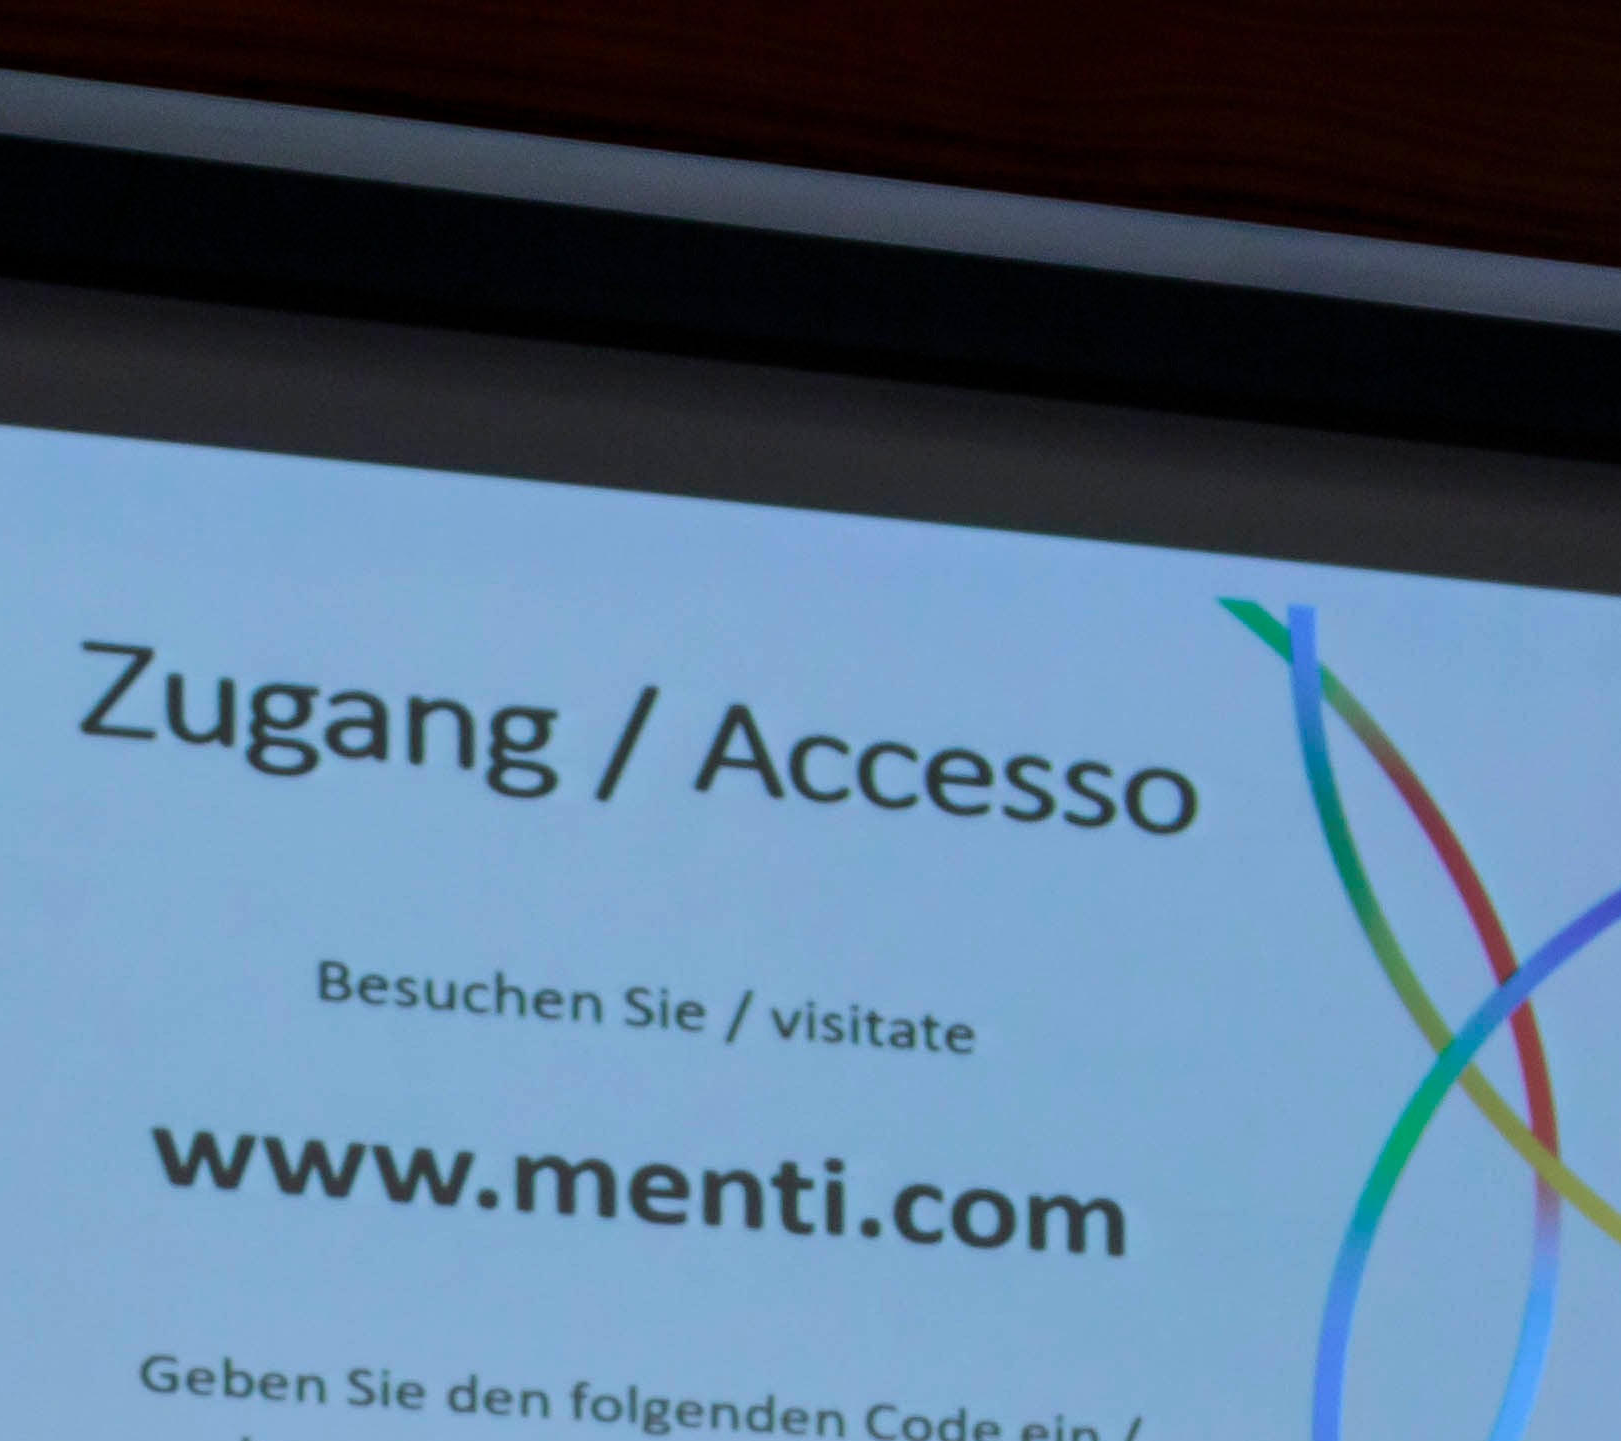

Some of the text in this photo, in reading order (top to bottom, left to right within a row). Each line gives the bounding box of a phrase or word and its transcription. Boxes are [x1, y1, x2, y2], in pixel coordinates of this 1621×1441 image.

[79, 639, 1199, 836] Zugang / Accesso
[318, 961, 976, 1055] Besuchen Sie / visitate
[151, 1125, 1127, 1257] www.menti.com
[139, 1355, 328, 1405] Geben
[347, 1367, 427, 1411] Sie
[446, 1374, 553, 1419] den
[570, 1381, 846, 1438] folgenden
